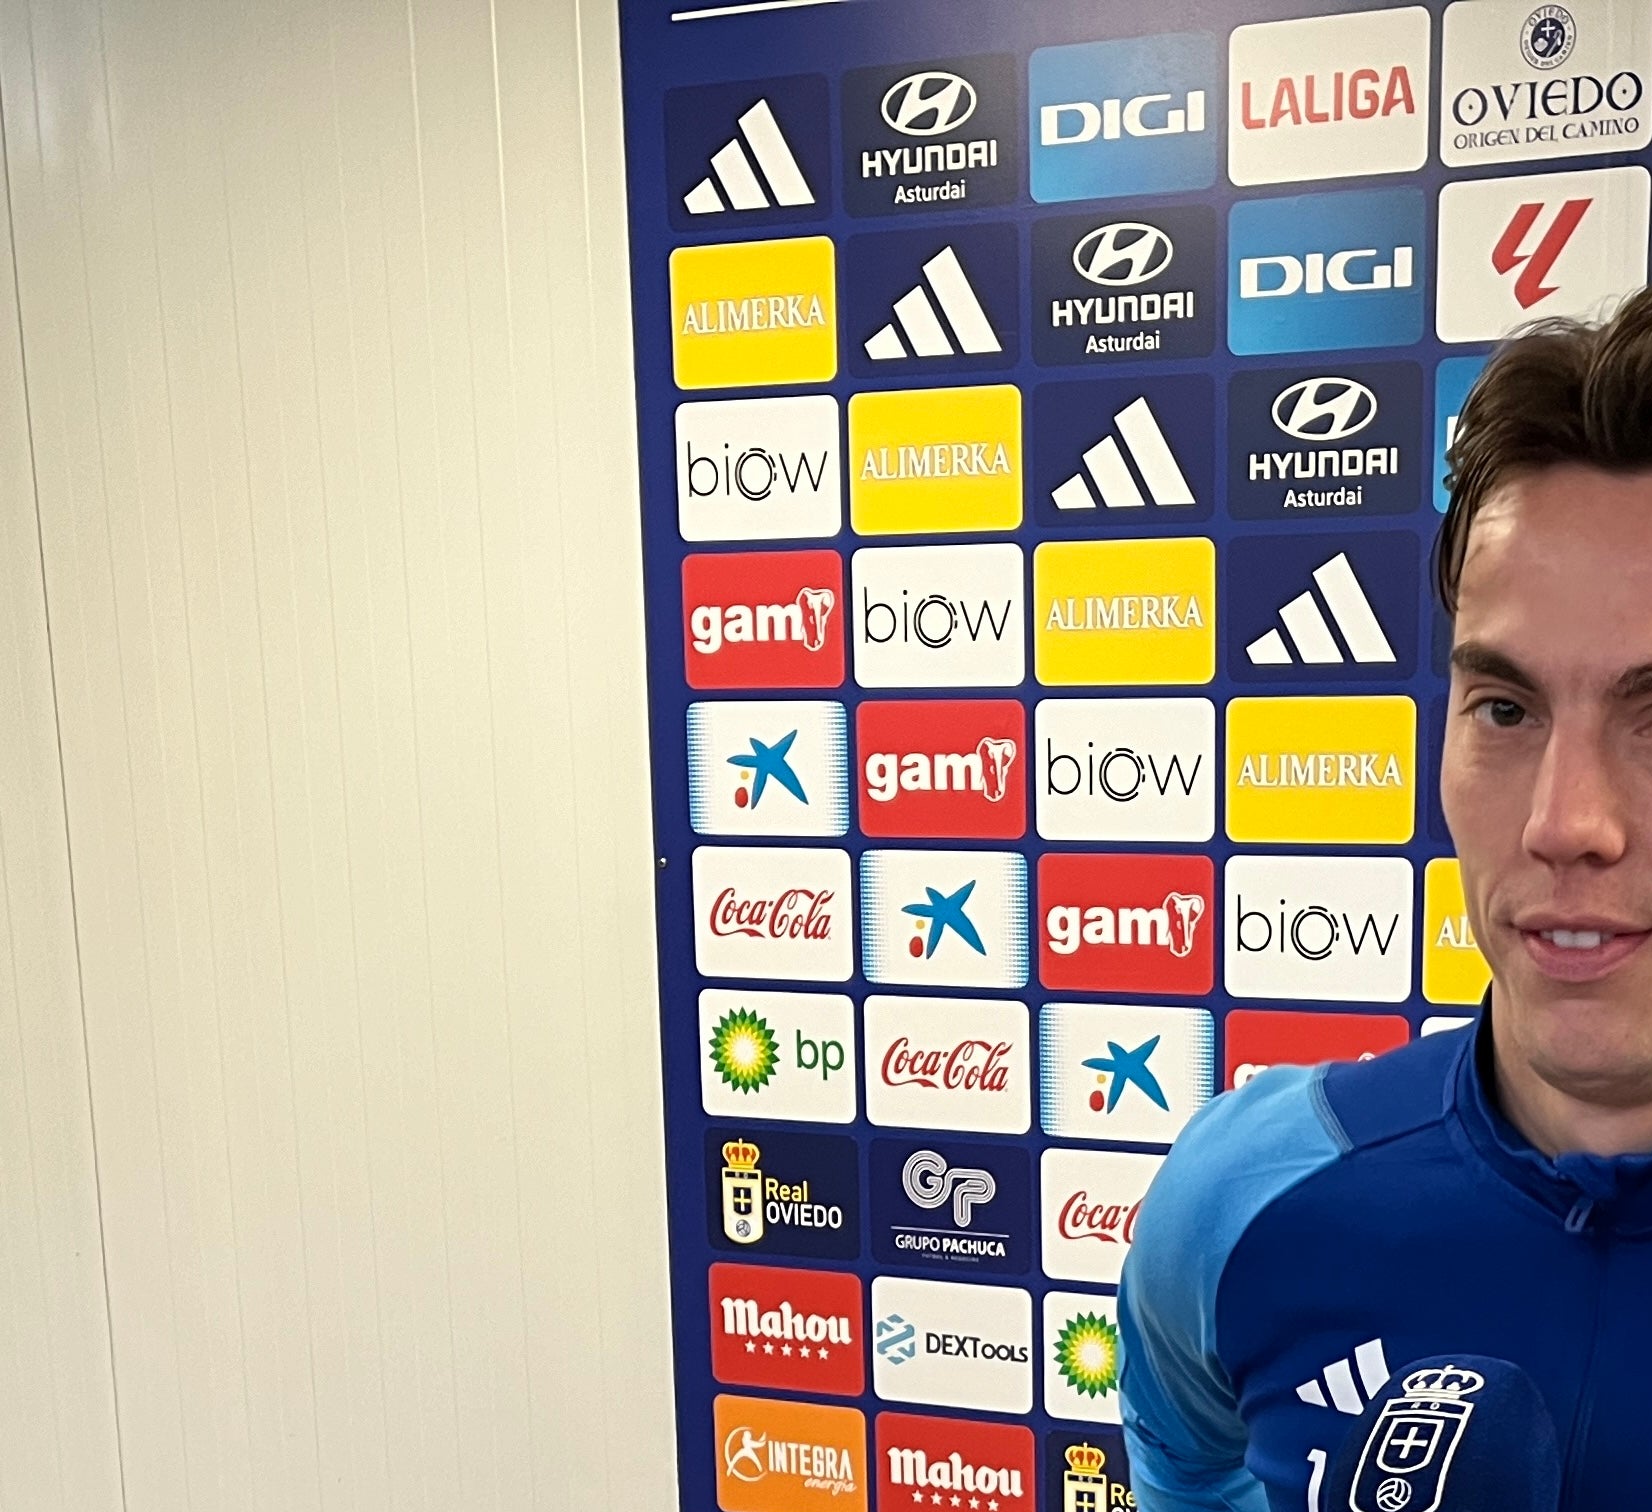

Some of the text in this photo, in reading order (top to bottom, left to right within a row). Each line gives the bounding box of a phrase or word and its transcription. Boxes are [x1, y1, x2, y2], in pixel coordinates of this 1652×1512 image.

[1242, 66, 1415, 129] LALIGA
[1453, 72, 1642, 126] OVIEDO
[1041, 91, 1204, 145] DIGI
[1454, 117, 1639, 149] ORIGEN DEL CAMINO
[863, 140, 997, 177] HYUNDAI
[895, 180, 965, 203] Asturdai
[1241, 247, 1412, 298] DIGI
[682, 295, 826, 334] ALIMERKA
[1053, 292, 1193, 326] HYUNDAI
[1086, 330, 1159, 353] Asturdai
[861, 443, 1011, 480] ALIMERKA
[1250, 448, 1397, 480] HYUNDAI
[1284, 486, 1362, 507] Asturdai
[1046, 595, 1204, 631] ALIMERKA
[1238, 754, 1402, 787] ALIMERKA
[797, 1029, 844, 1080] bp
[766, 1178, 807, 1202] Real
[767, 1202, 842, 1228] OVIEDO
[895, 1234, 1006, 1257] GRUPO PACHUCA
[721, 1298, 852, 1344] Mahou
[768, 1441, 853, 1481] INTEGRA
[888, 1448, 1023, 1497] Mahou
